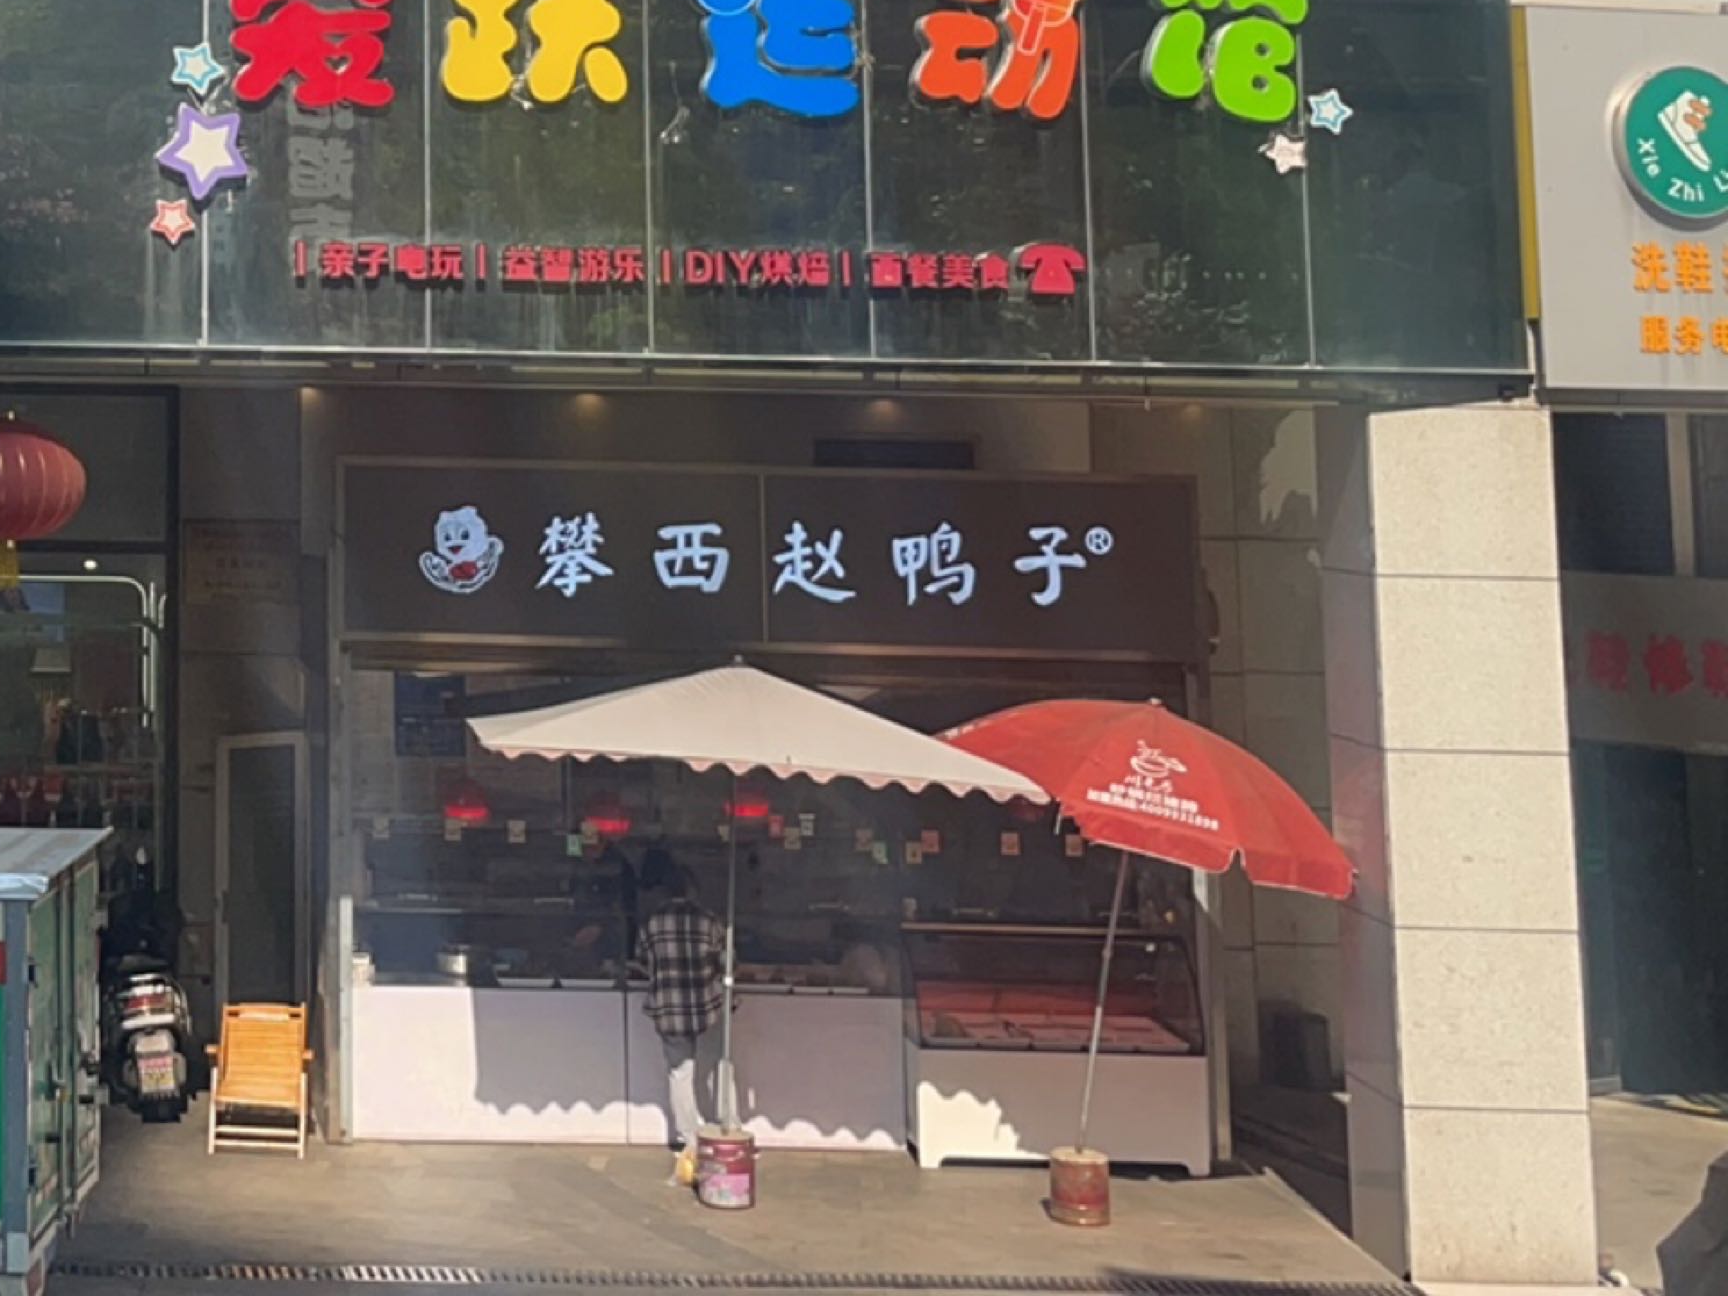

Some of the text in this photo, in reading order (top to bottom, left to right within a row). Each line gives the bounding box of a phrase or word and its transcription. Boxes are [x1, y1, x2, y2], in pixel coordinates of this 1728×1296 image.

[1631, 240, 1728, 295] 洗鞋
[534, 513, 1088, 607] 攀西赵鸭子
